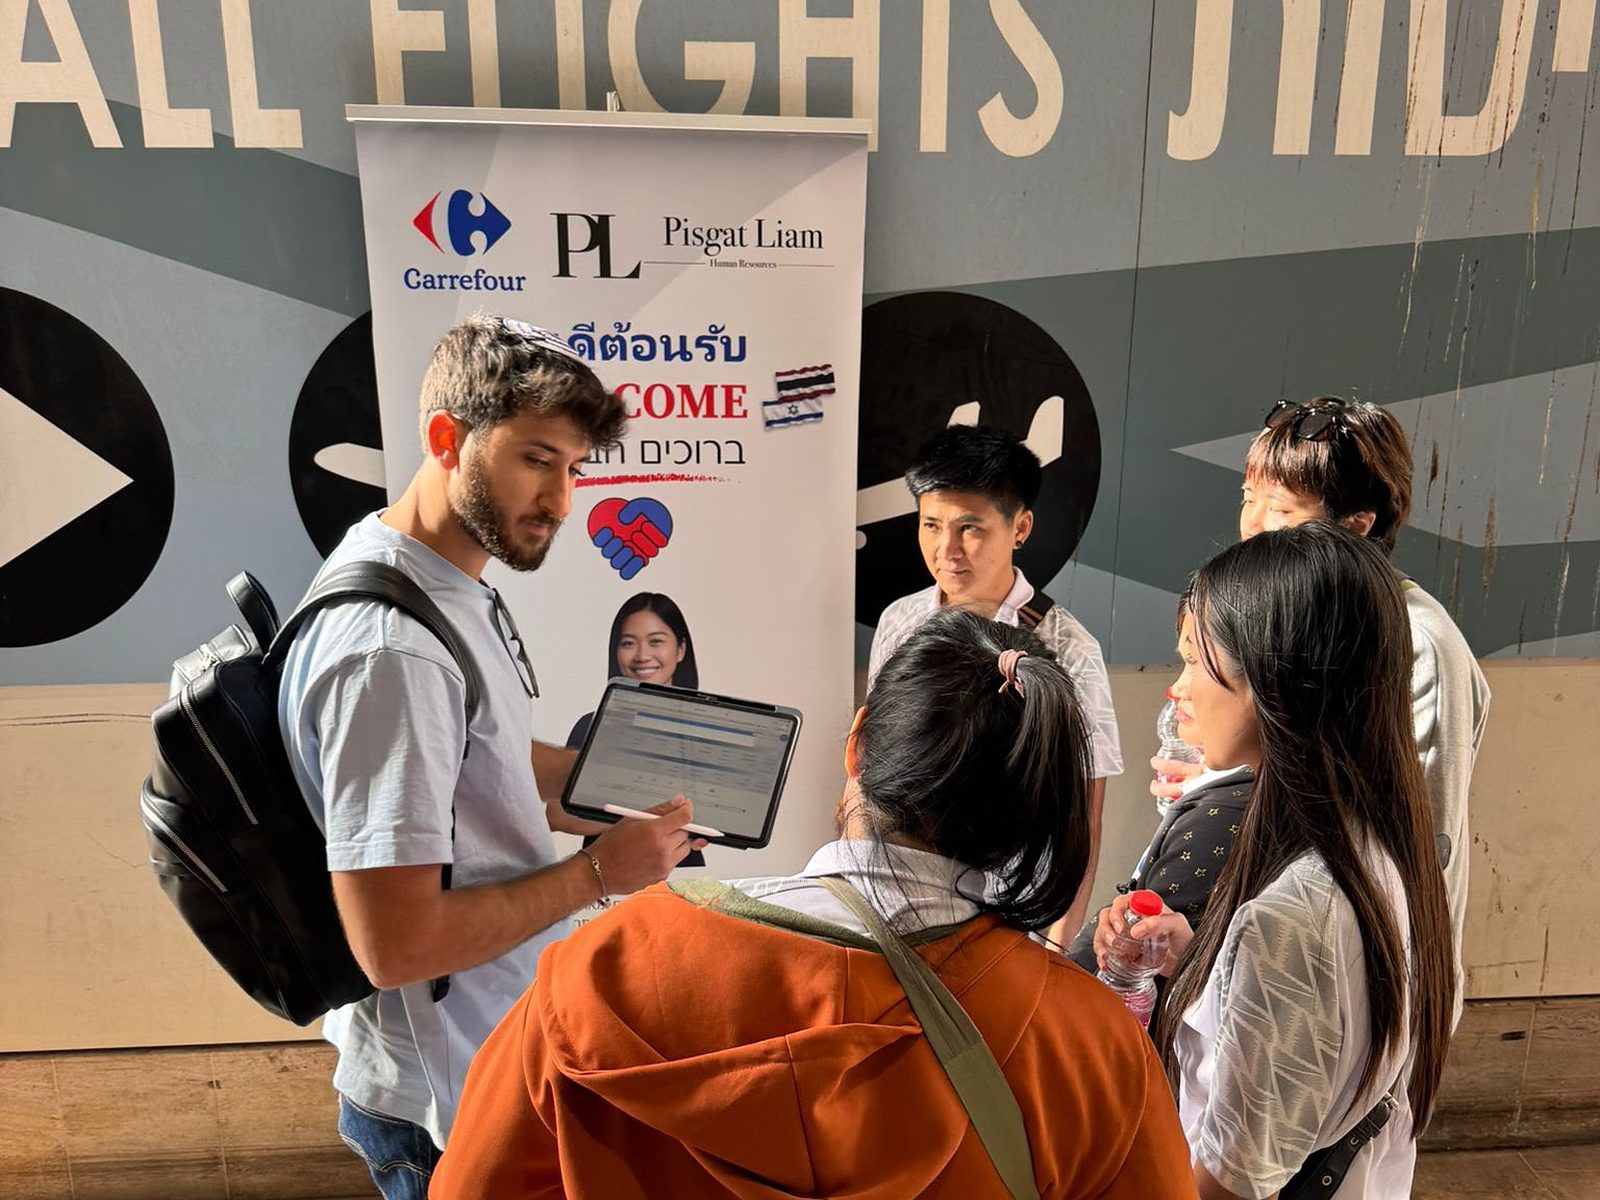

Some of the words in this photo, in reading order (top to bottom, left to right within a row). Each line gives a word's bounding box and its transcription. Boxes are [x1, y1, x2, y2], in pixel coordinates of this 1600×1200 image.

[550, 213, 642, 279] PL
[663, 216, 748, 256] Pisgat
[755, 219, 823, 249] Liam
[403, 267, 526, 291] Carrefour
[710, 258, 737, 268] Human
[739, 260, 777, 269] Resources
[567, 322, 747, 362] ดีต้อนรับ
[614, 383, 748, 419] COME
[641, 440, 746, 464] ברוכים
